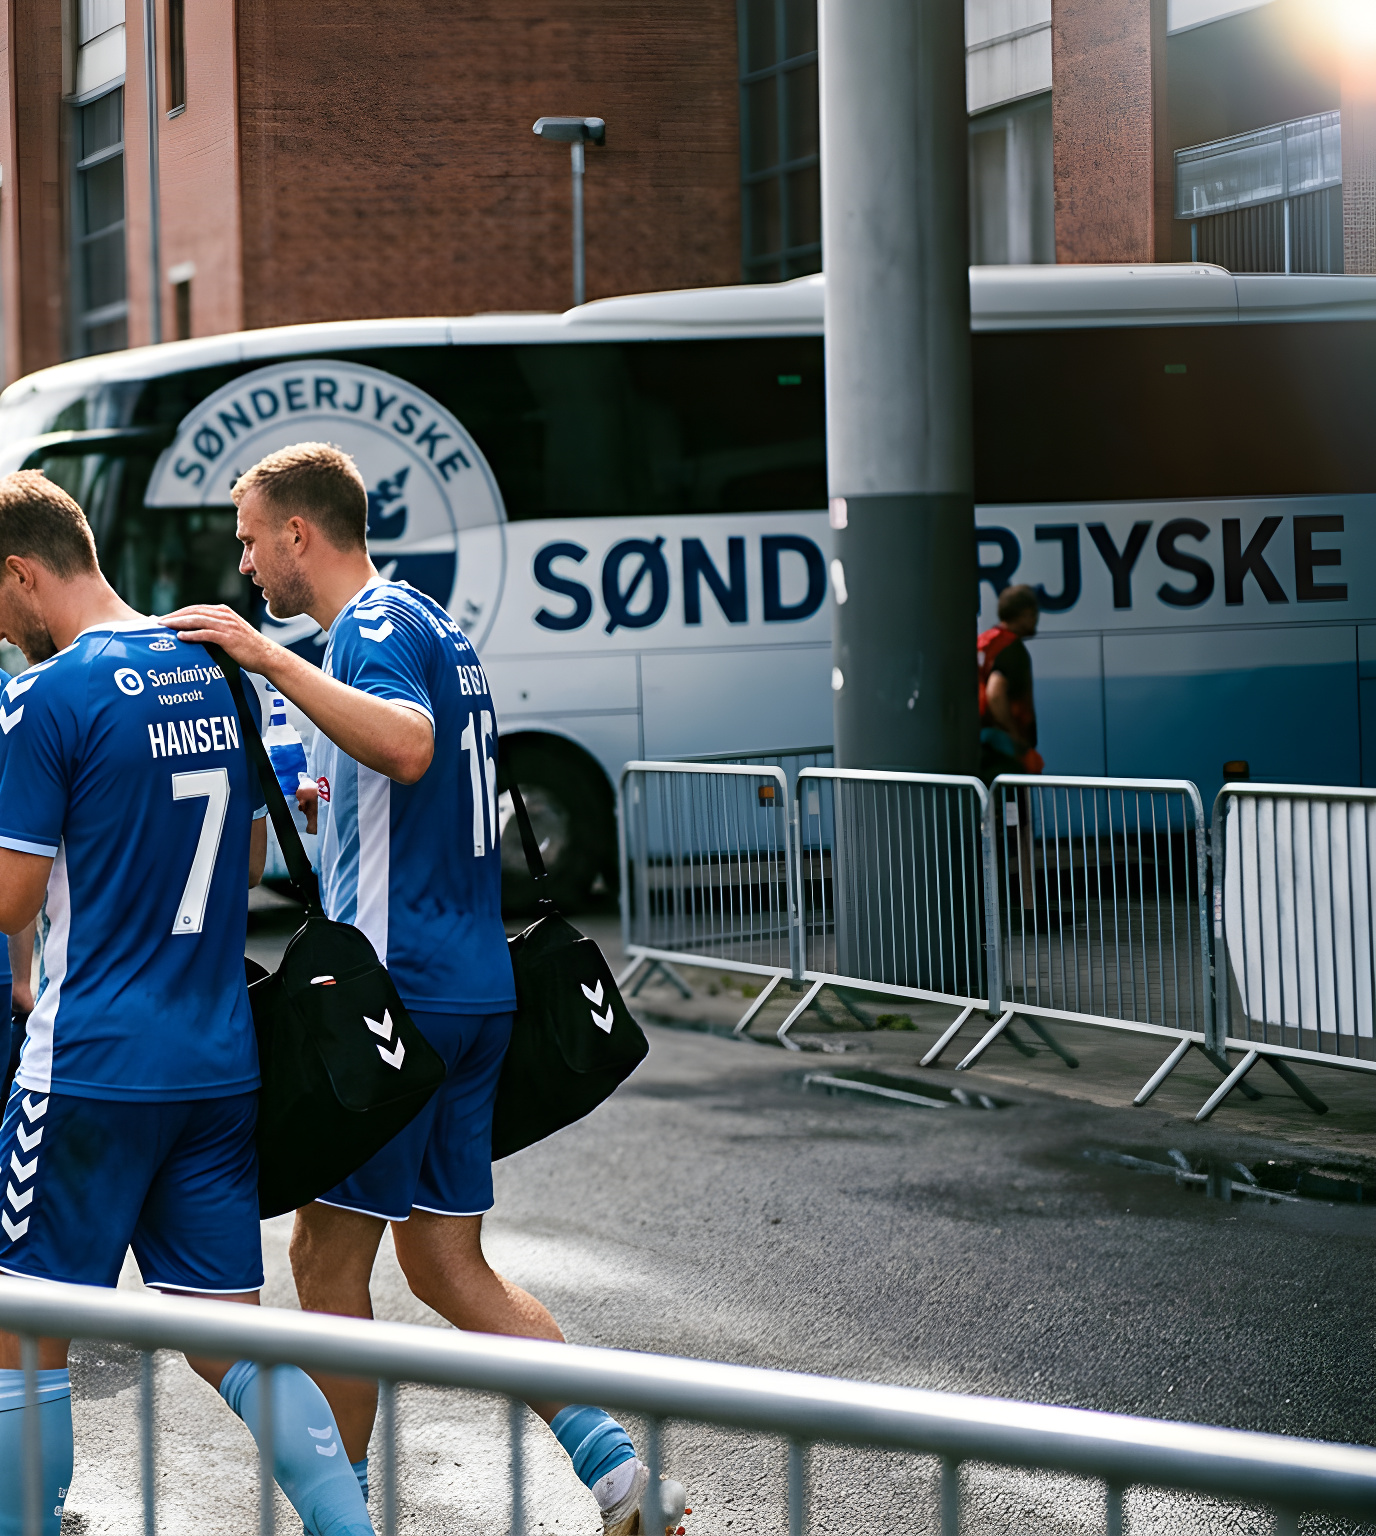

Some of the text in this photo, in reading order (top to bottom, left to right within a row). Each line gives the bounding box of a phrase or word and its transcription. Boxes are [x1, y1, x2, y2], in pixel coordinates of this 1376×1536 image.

[173, 376, 471, 487] SØNDERJYSKE
[532, 515, 1348, 635] SØNDRJYSKE
[147, 715, 240, 759] HANSEN
[171, 767, 231, 935] 7
